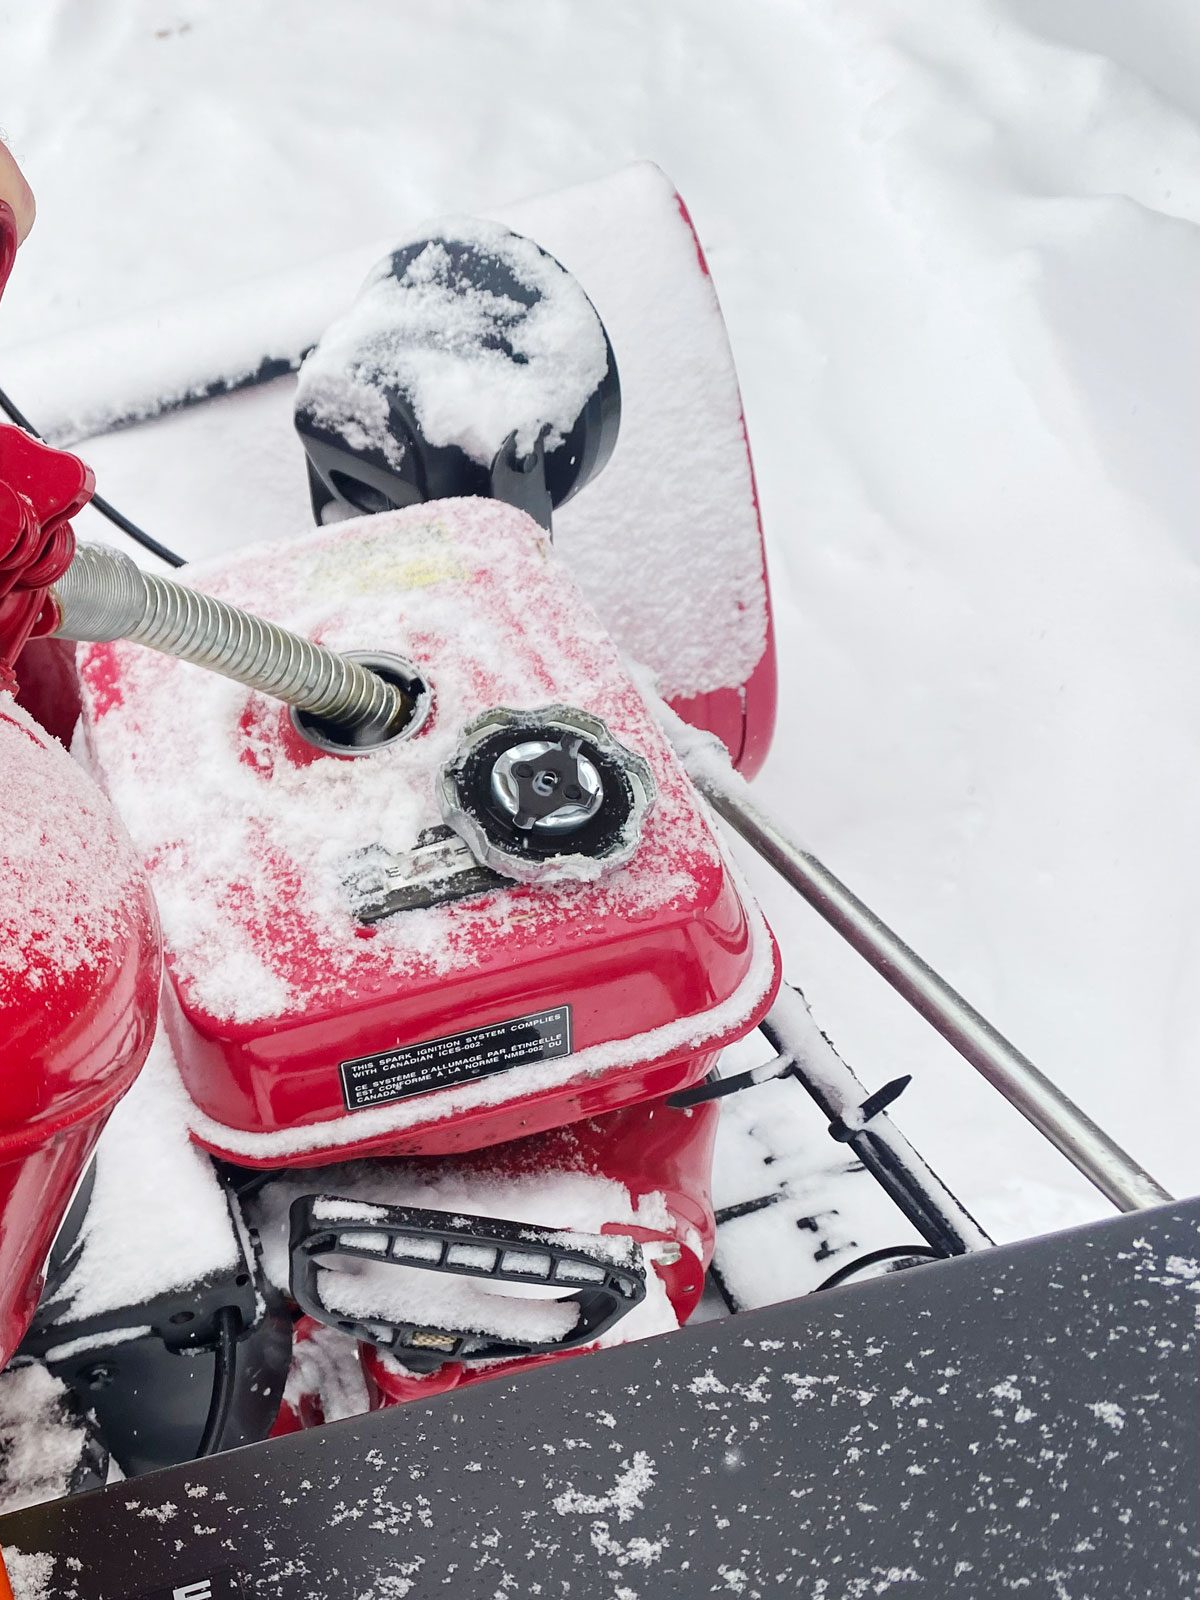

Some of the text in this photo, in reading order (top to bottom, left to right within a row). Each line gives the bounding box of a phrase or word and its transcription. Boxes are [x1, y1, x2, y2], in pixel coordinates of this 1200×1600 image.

[351, 1013, 561, 1072] THIS SPARK IGNITION SYSTEM COMPLIES
[352, 1042, 484, 1078] WITH CANADIAN ICES-002.
[354, 1083, 368, 1091] CE
[421, 1054, 482, 1075] D'ALLUMAGE
[487, 1048, 506, 1057] PAR
[356, 1088, 374, 1097] EST
[378, 1073, 432, 1092] CONFORME
[448, 1066, 461, 1074] LA
[465, 1056, 500, 1069] NORME
[504, 1045, 544, 1059] NMB-002
[548, 1039, 562, 1048] DU
